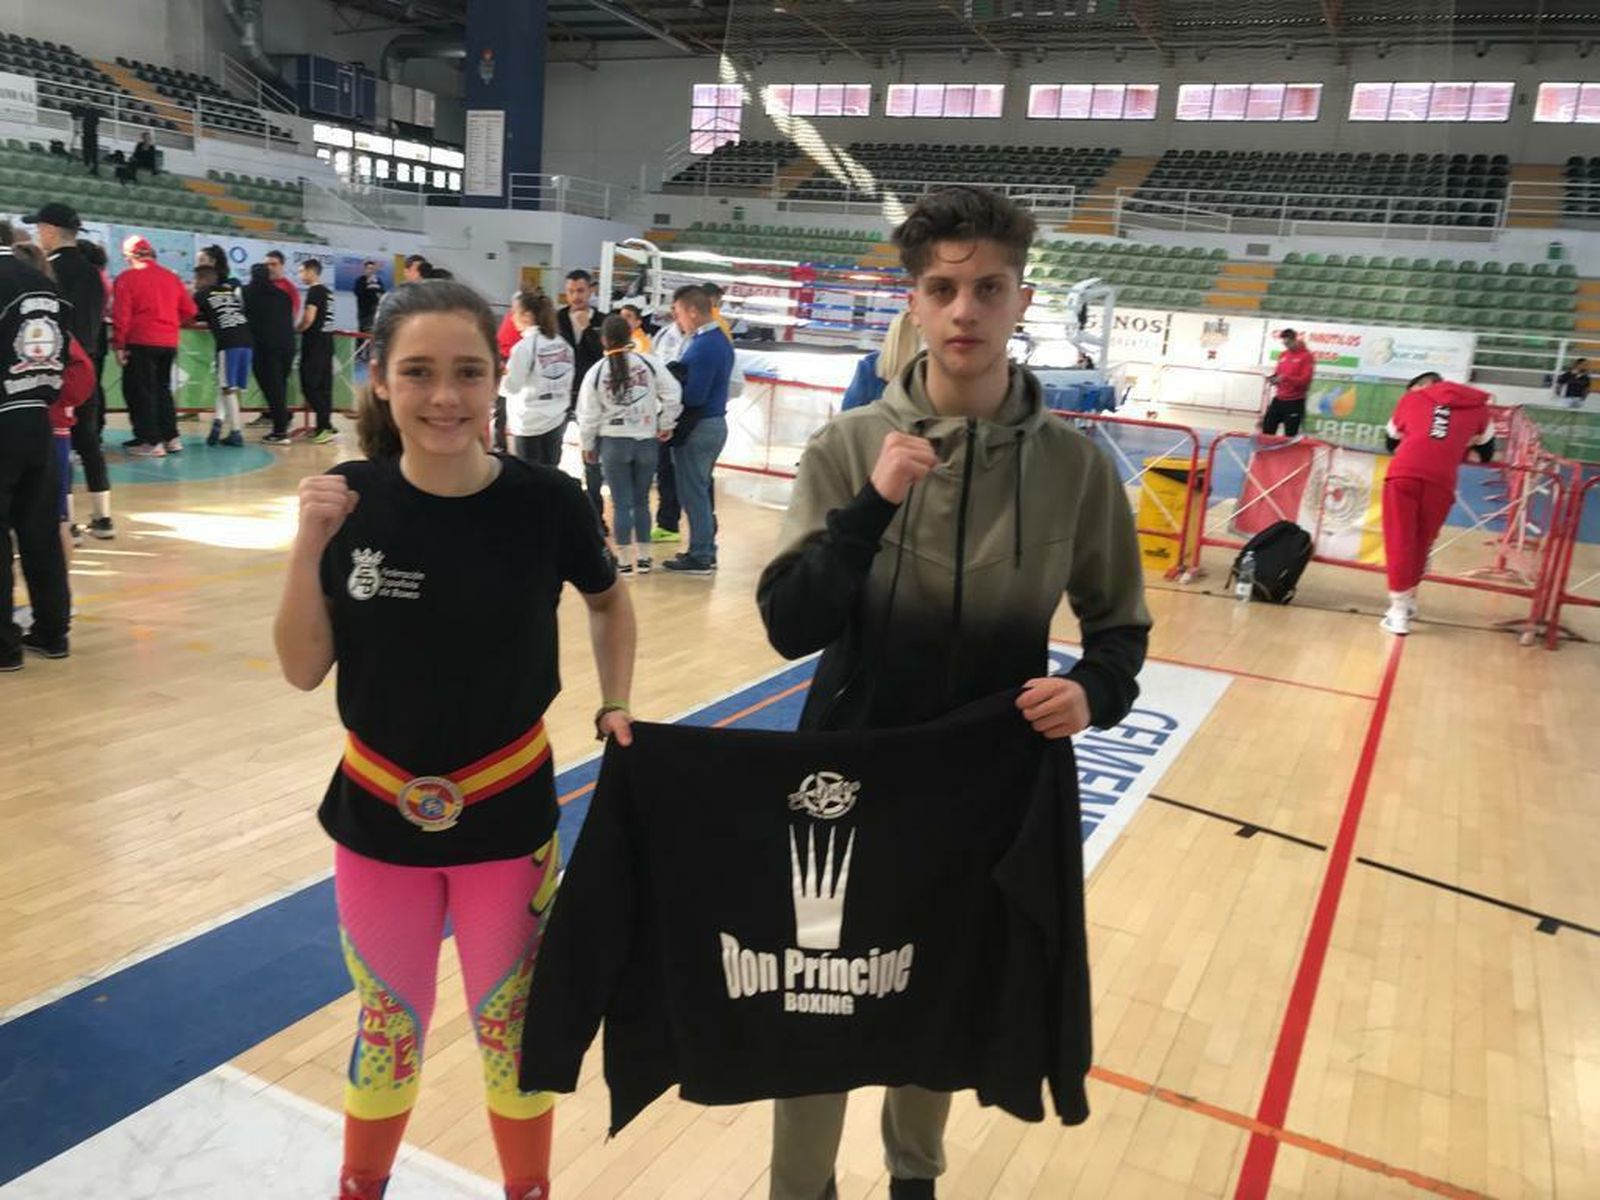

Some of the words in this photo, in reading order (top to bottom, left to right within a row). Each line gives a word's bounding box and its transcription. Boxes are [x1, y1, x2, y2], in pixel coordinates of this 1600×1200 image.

[1074, 707, 1180, 843] CEMEN
[719, 931, 778, 999] Don
[784, 942, 914, 998] Príncipe
[784, 991, 854, 1015] BOXING
